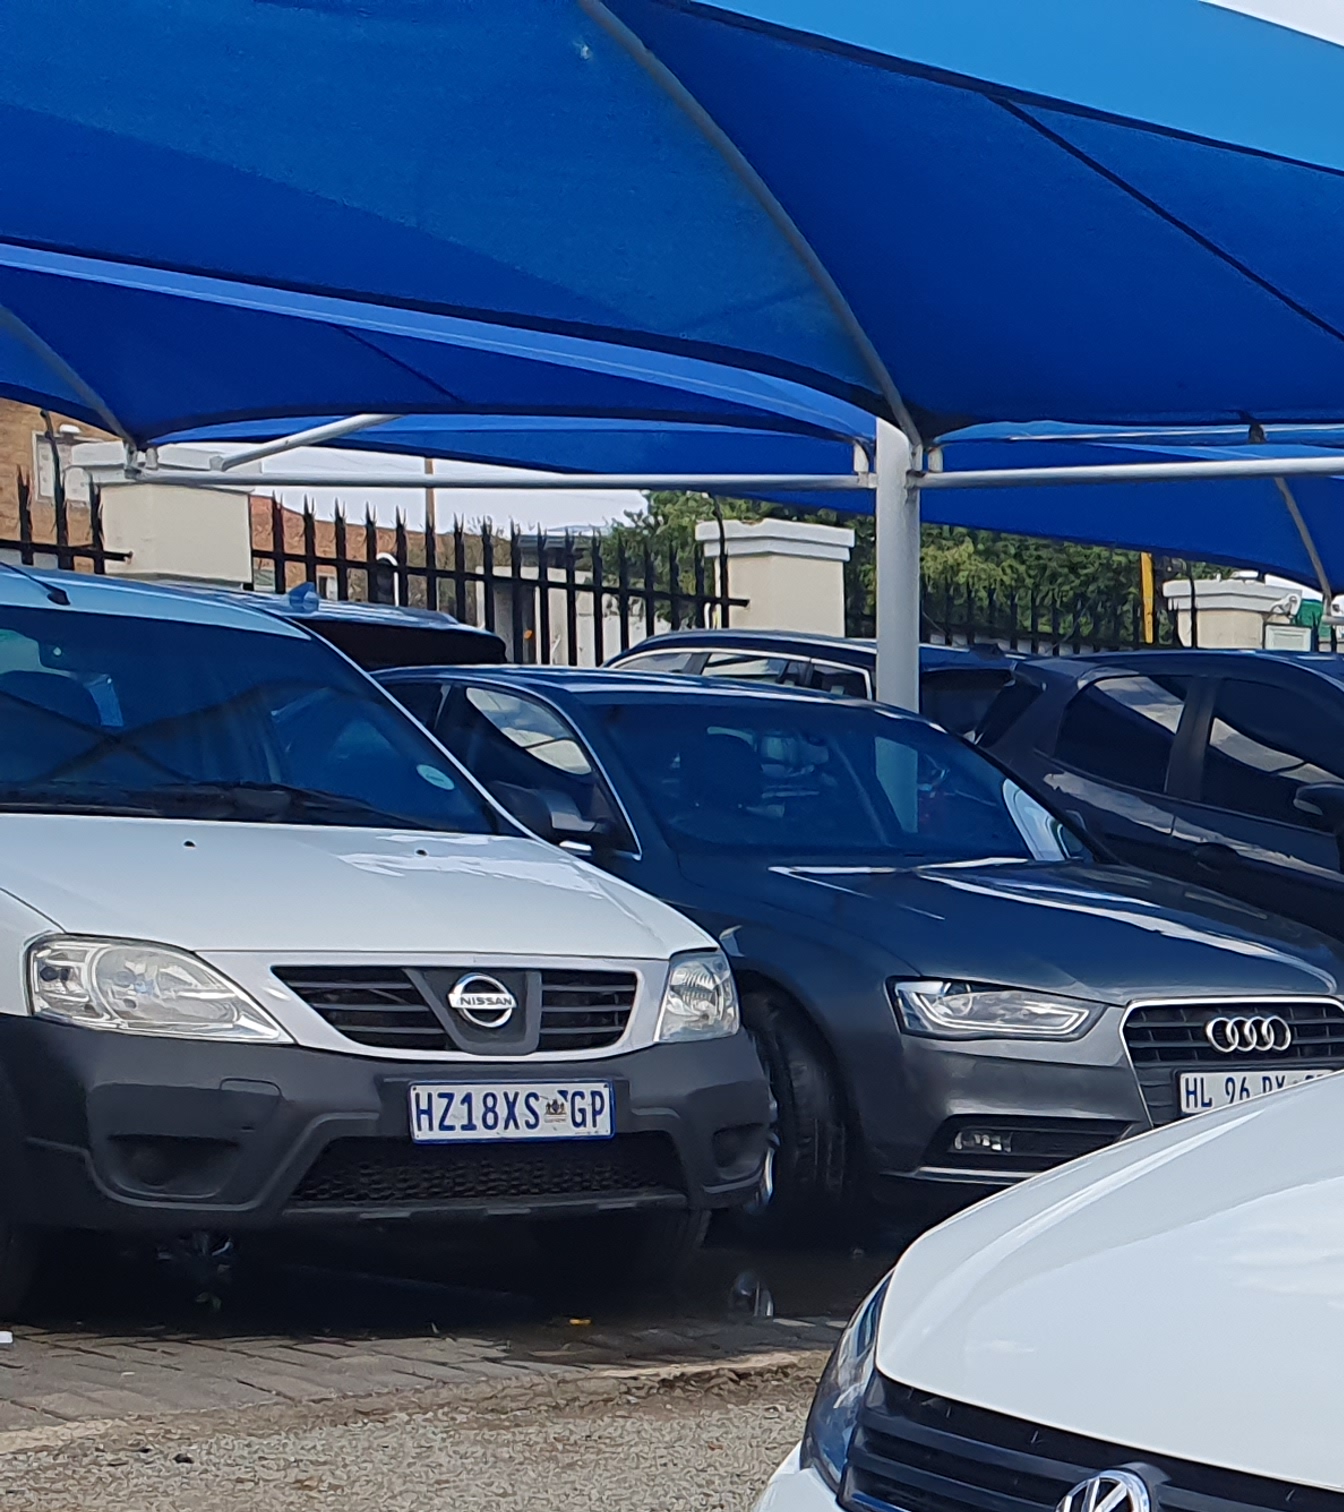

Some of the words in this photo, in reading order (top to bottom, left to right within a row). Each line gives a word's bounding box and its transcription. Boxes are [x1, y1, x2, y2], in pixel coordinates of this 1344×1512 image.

[459, 996, 513, 1007] NISSAN
[1184, 1077, 1213, 1108] HL
[415, 1091, 540, 1132] HZ18XS
[570, 1090, 606, 1129] GP
